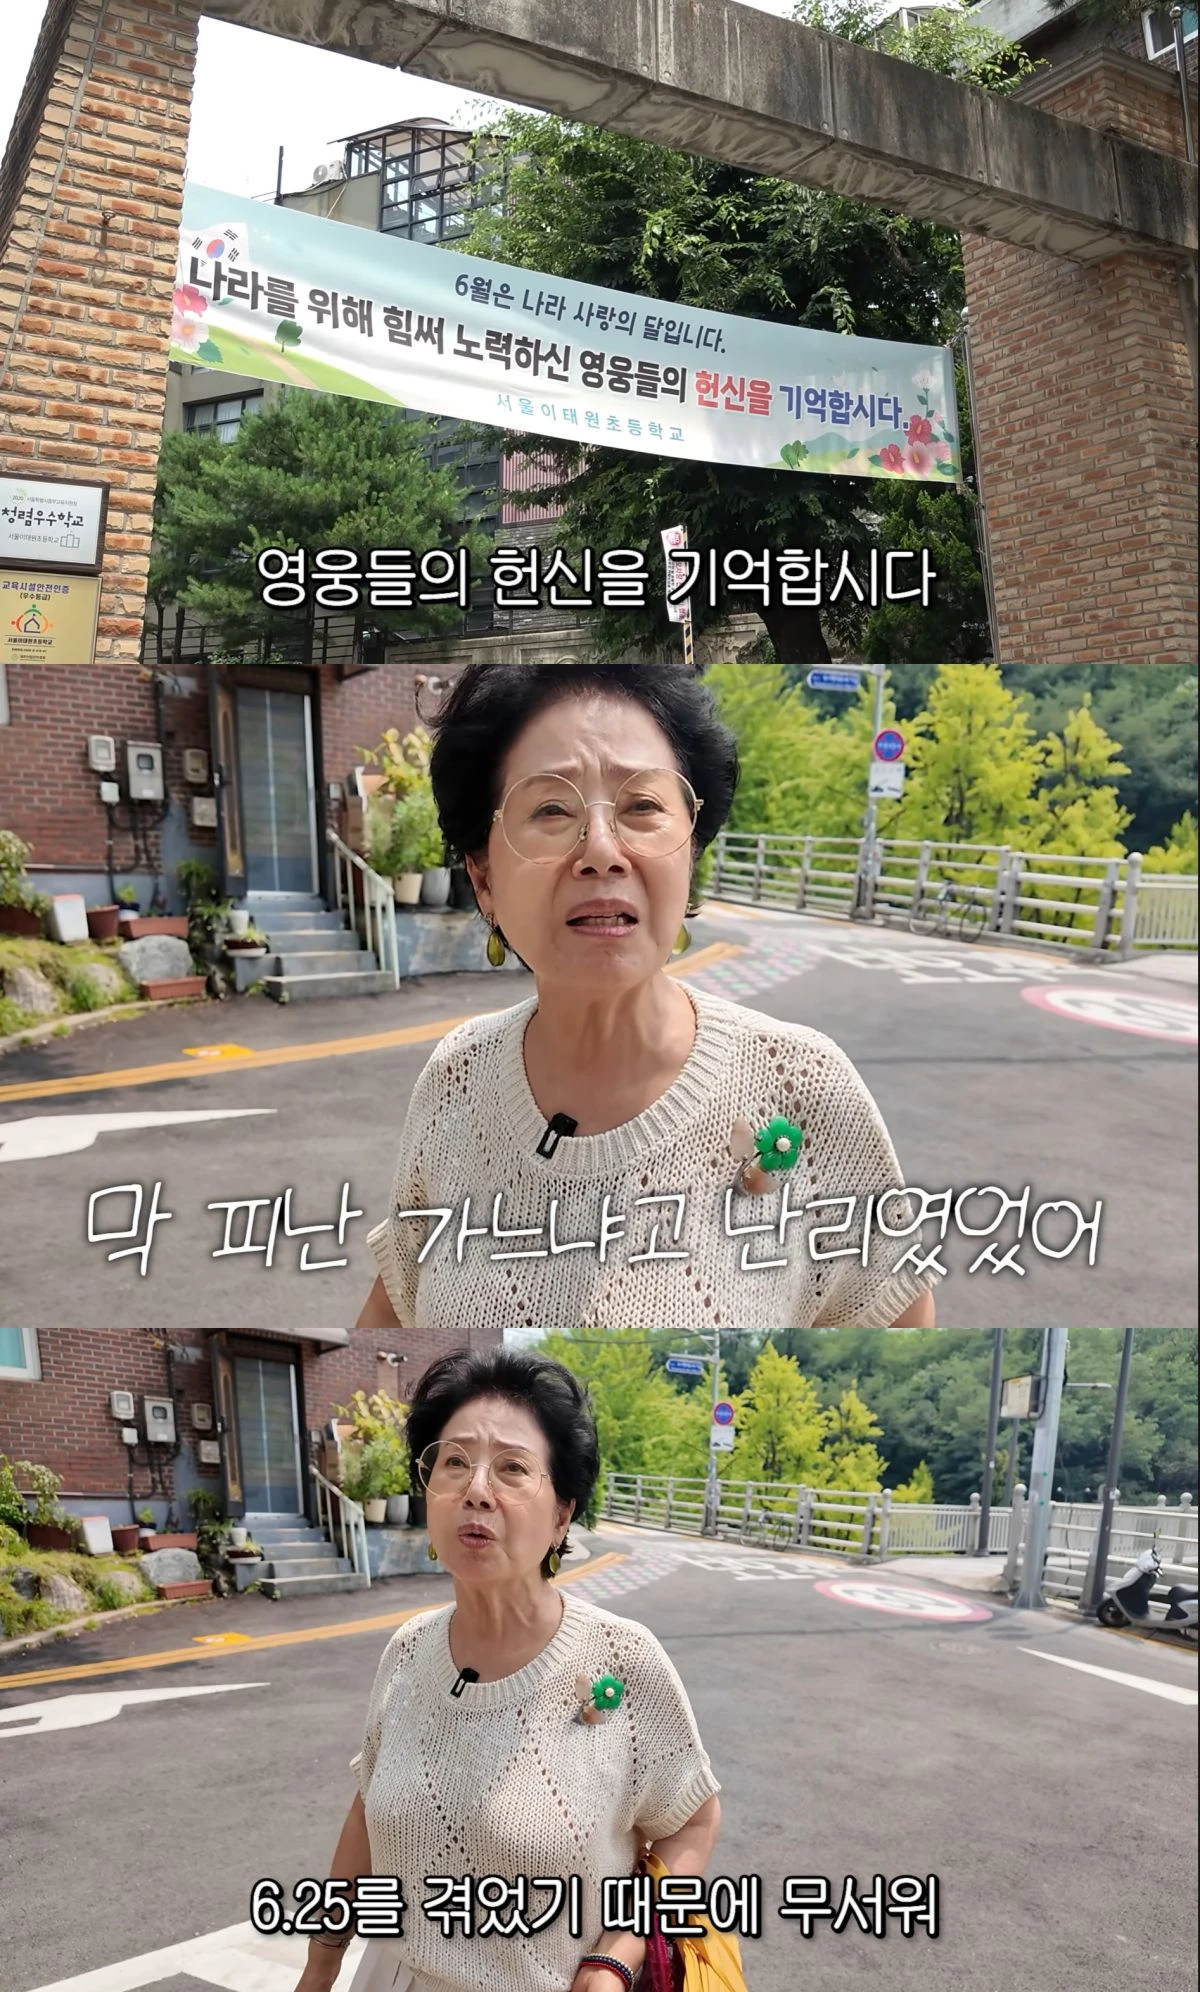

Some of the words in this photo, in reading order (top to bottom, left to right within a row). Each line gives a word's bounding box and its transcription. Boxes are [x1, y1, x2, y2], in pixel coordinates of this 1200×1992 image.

[189, 256, 299, 320] 나라를
[308, 287, 374, 338] 위해
[383, 305, 445, 355] 힘써
[453, 324, 572, 383] 노력하신
[579, 350, 688, 404] 영웅들의
[695, 370, 773, 417] 헌신을
[779, 384, 910, 432] 기억합시다.
[455, 273, 515, 310] 6월은
[522, 288, 567, 321] 나라
[573, 300, 638, 337] 사랑의
[644, 314, 727, 354] 달입니다.
[496, 394, 685, 443] 서울이태원초등학교
[1, 506, 84, 528] 청렴우수학교
